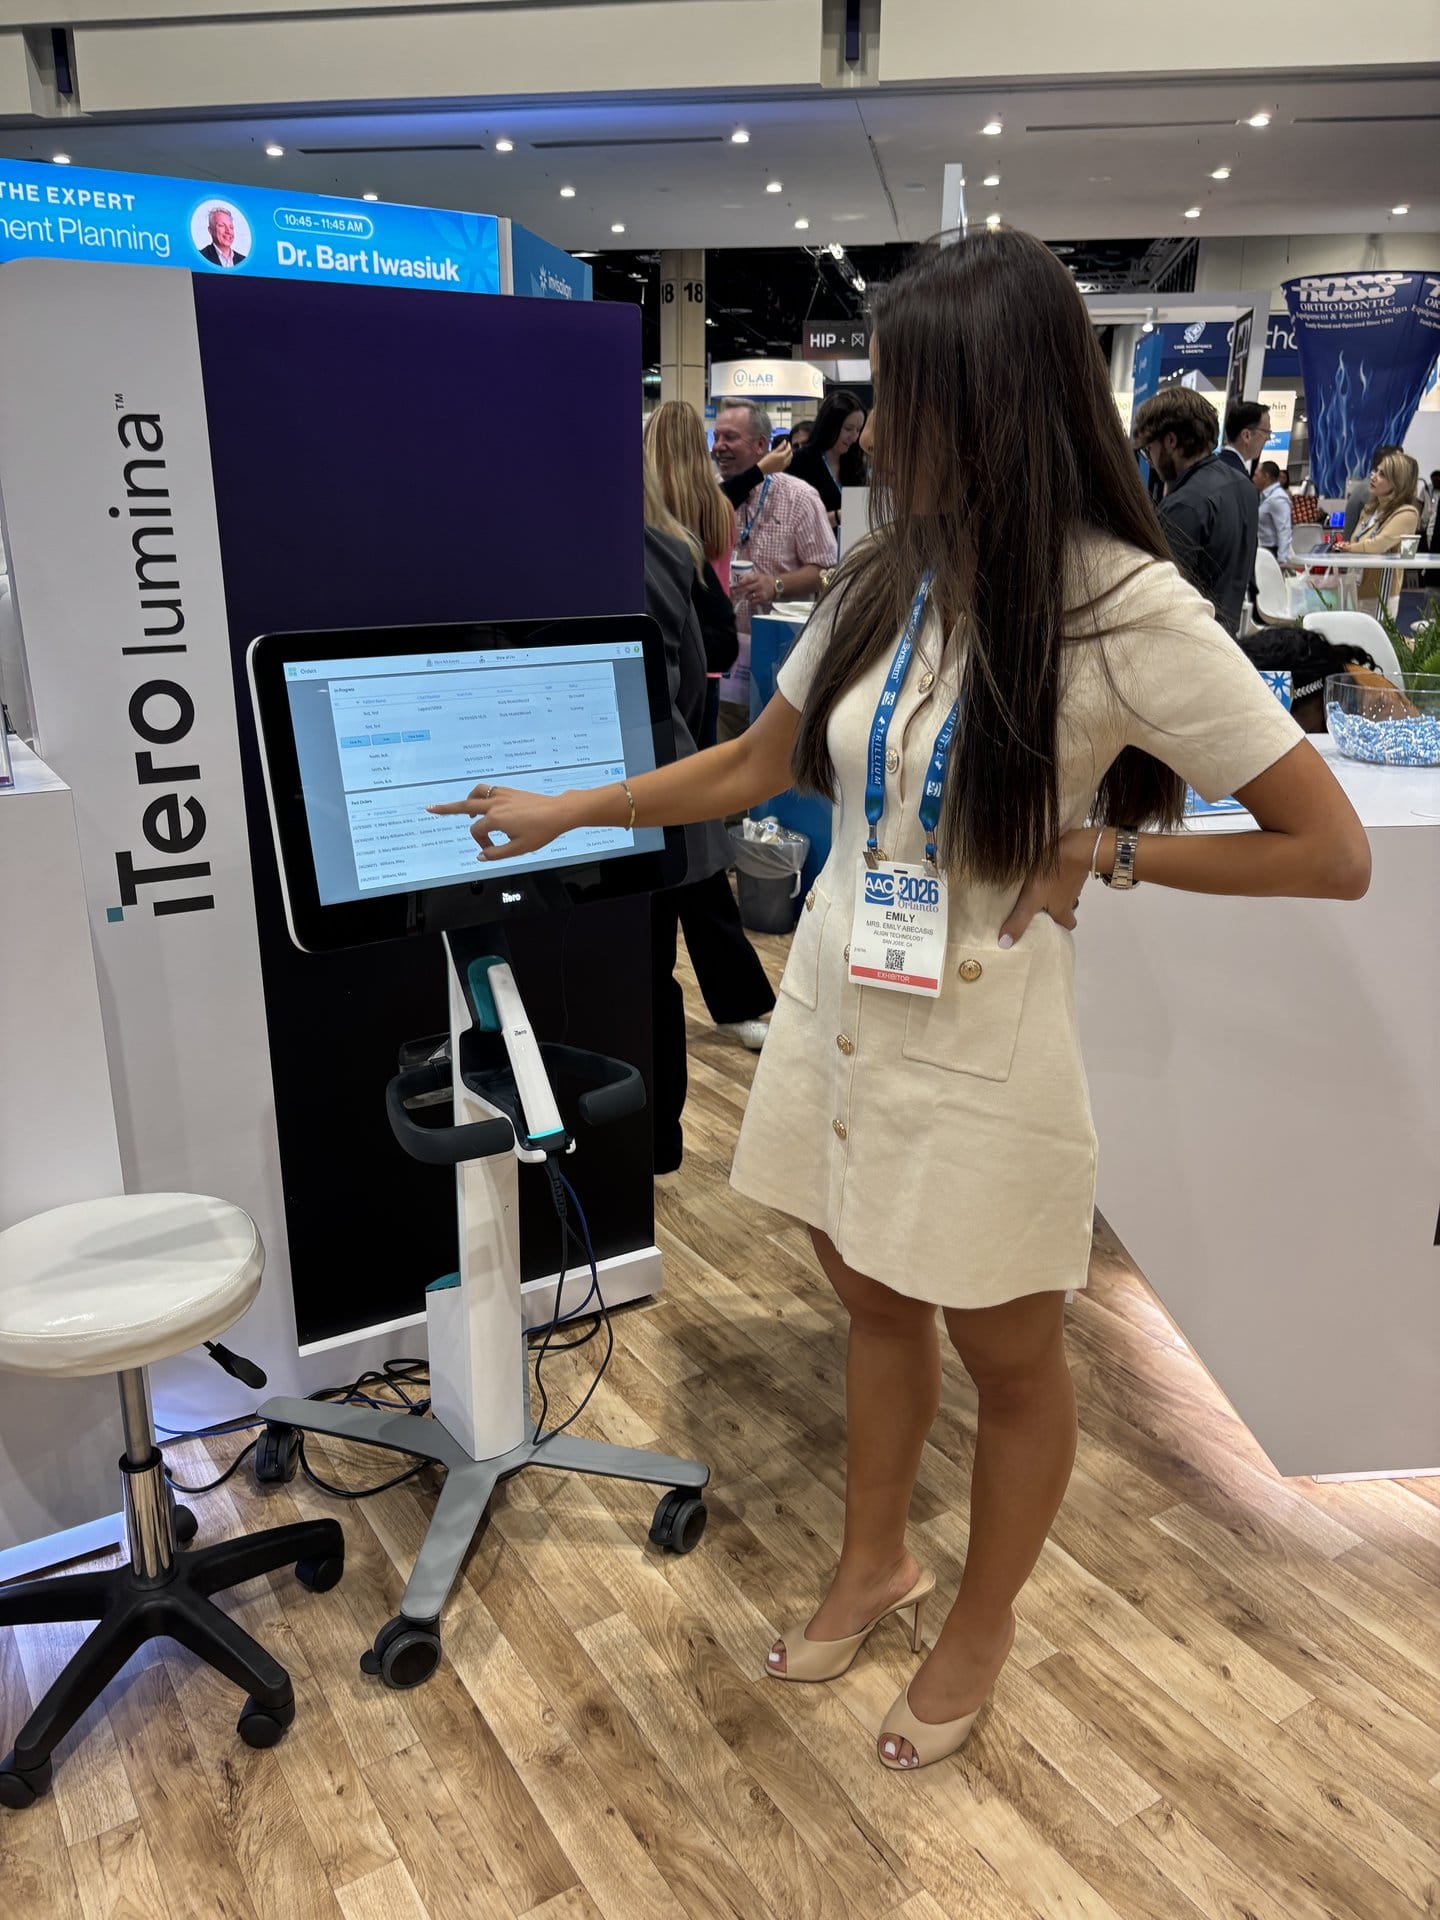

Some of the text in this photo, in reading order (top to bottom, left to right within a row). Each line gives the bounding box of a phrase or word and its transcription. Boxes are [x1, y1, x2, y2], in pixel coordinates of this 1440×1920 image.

[0, 181, 135, 211] THE EXPERT
[347, 220, 363, 233] AM
[58, 217, 170, 258] Planning
[277, 240, 460, 282] Dr. Bart Iwasiuk
[684, 282, 704, 304] 18
[1291, 273, 1413, 302] ROSS
[1300, 296, 1396, 312] ORTHODONTIC
[1340, 309, 1372, 320] Facility
[1375, 304, 1409, 317] Design
[810, 333, 837, 348] HIP
[300, 667, 317, 675] Orders
[874, 727, 886, 785] TRILLIUM
[106, 679, 215, 923] iTero
[865, 876, 939, 905] AAO 2026
[898, 900, 939, 914] Orlando
[885, 911, 916, 923] EMILY
[866, 919, 881, 929] MRS.
[882, 923, 901, 932] EMILY
[877, 971, 910, 984] EXHIBITOR
